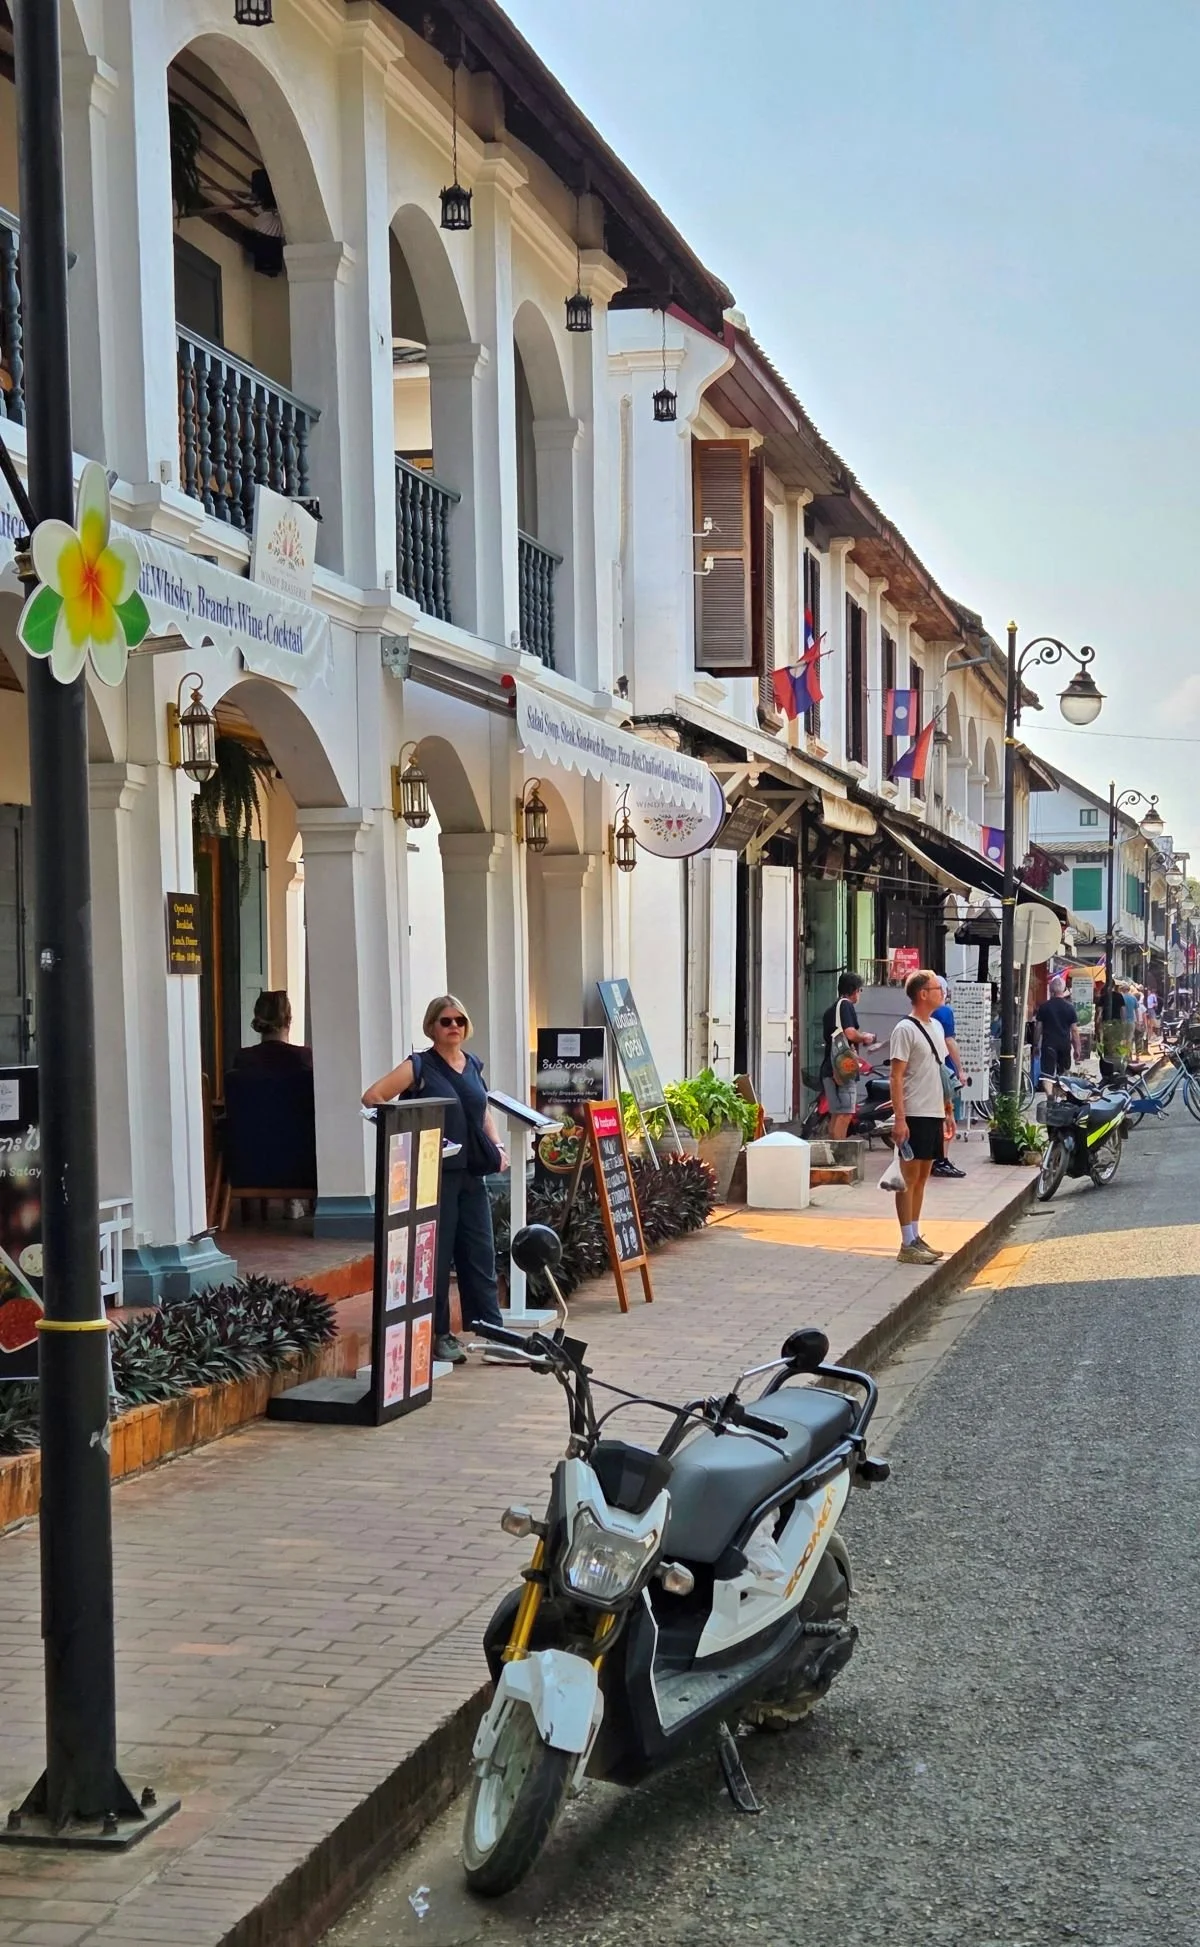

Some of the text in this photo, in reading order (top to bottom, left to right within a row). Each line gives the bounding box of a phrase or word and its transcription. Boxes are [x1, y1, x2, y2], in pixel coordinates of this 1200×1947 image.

[624, 1037, 645, 1059] OPEN
[9, 1167, 41, 1179] Satay
[784, 1483, 836, 1600] ZOOMER
